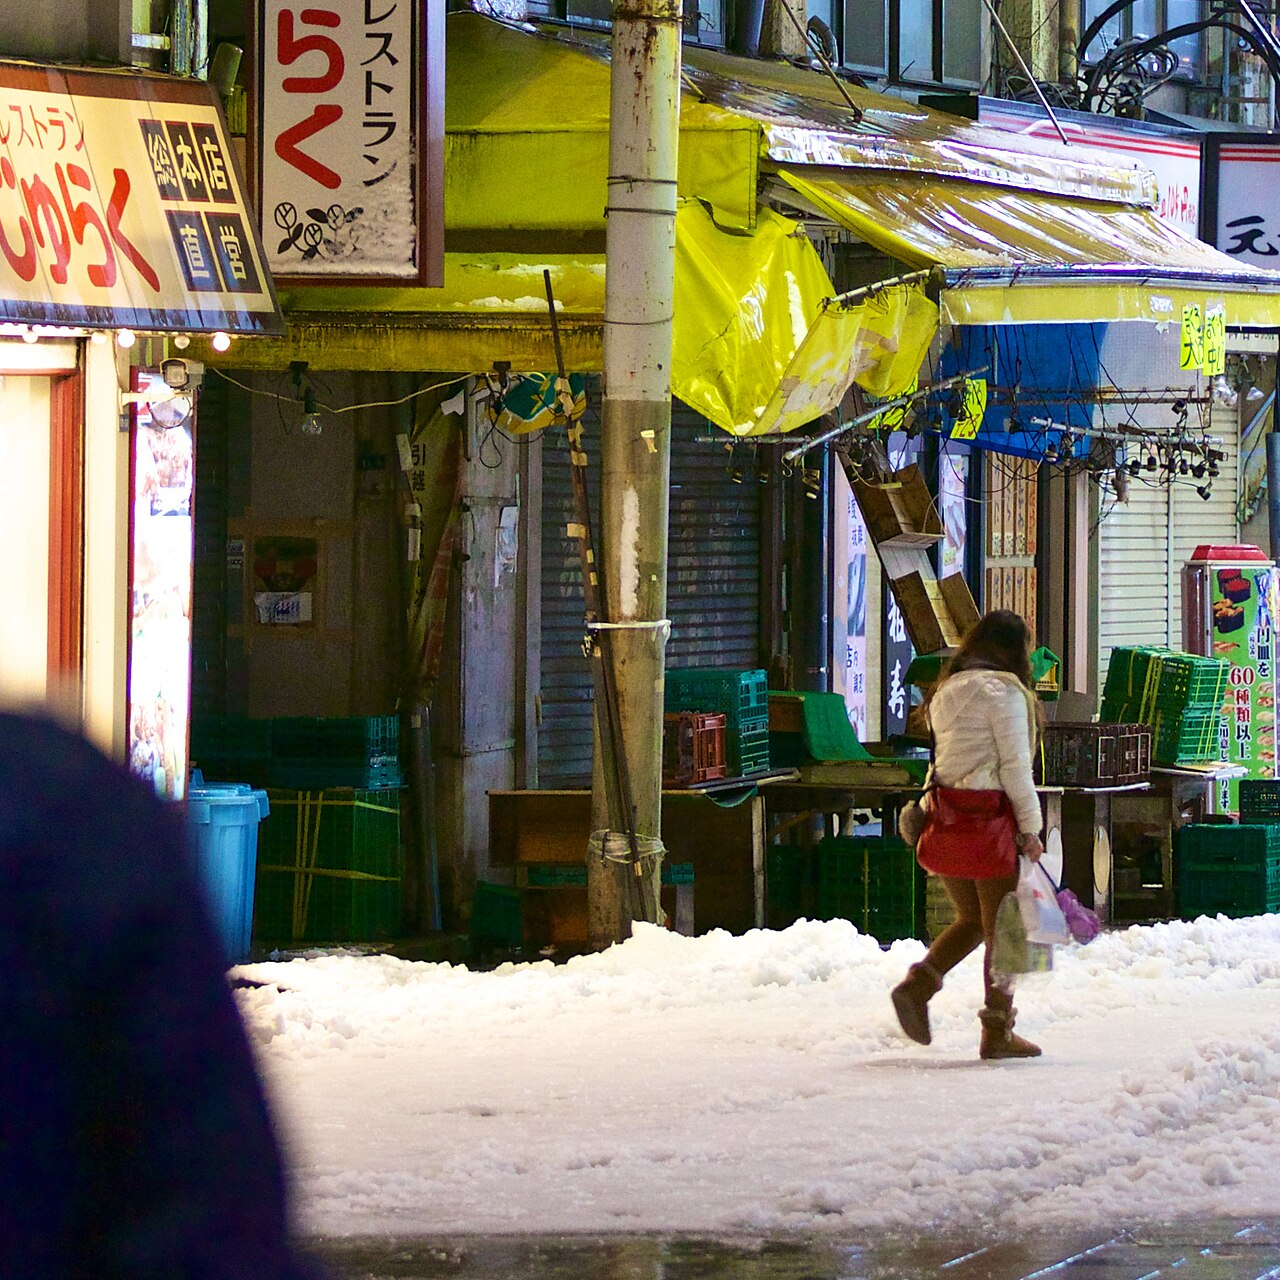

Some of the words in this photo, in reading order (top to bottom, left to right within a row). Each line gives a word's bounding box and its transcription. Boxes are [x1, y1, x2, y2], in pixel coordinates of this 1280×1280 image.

[148, 133, 228, 191] 総本店
[181, 224, 247, 282] 直営
[1230, 667, 1255, 761] 60種類以上
